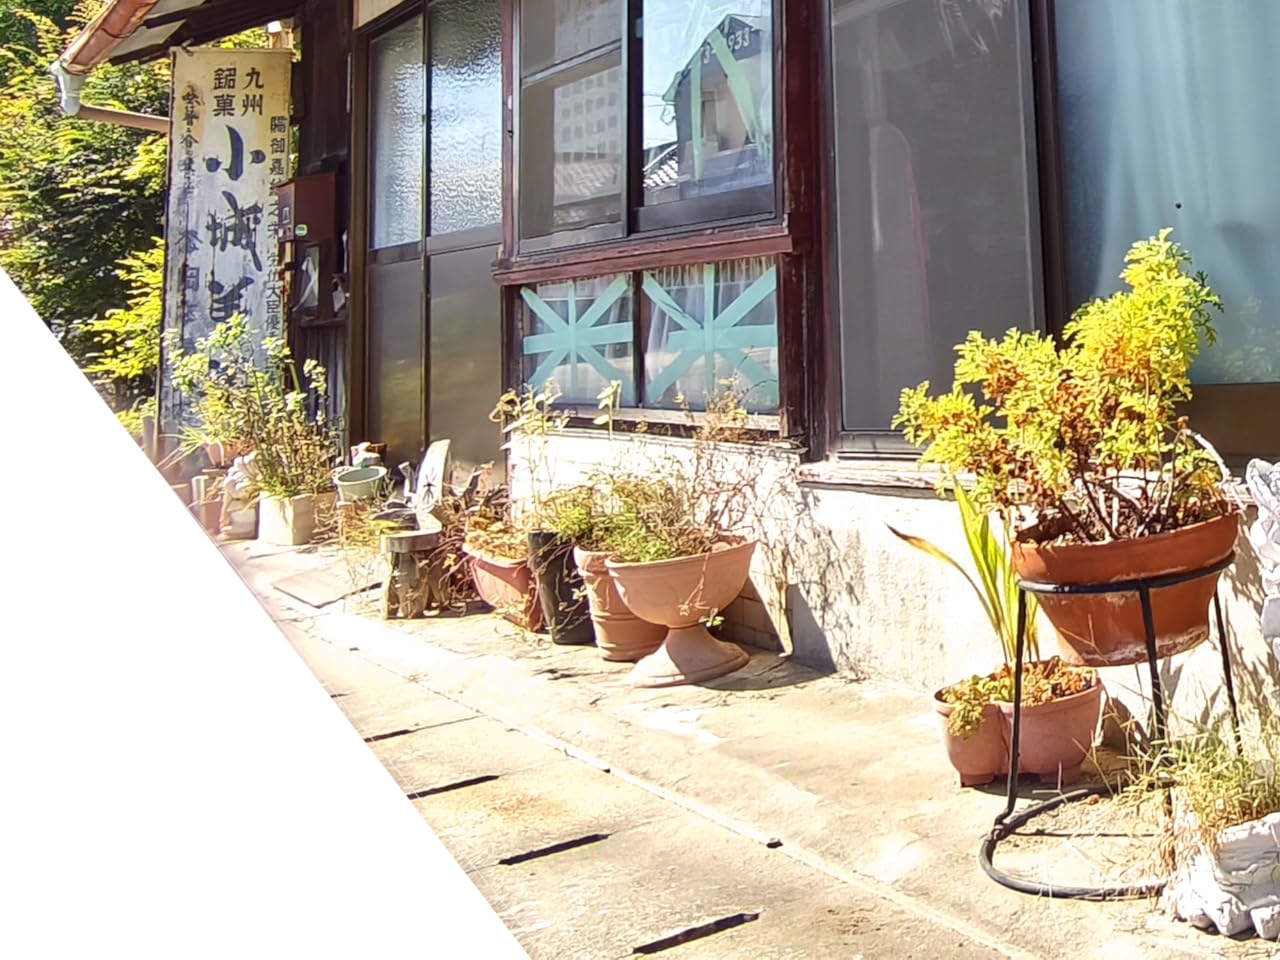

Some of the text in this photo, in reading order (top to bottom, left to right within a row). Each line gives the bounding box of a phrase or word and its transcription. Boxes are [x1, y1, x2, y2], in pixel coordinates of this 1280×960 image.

[213, 67, 237, 117] 銘菓
[242, 67, 265, 117] 九州
[204, 124, 267, 370] 小城羊
